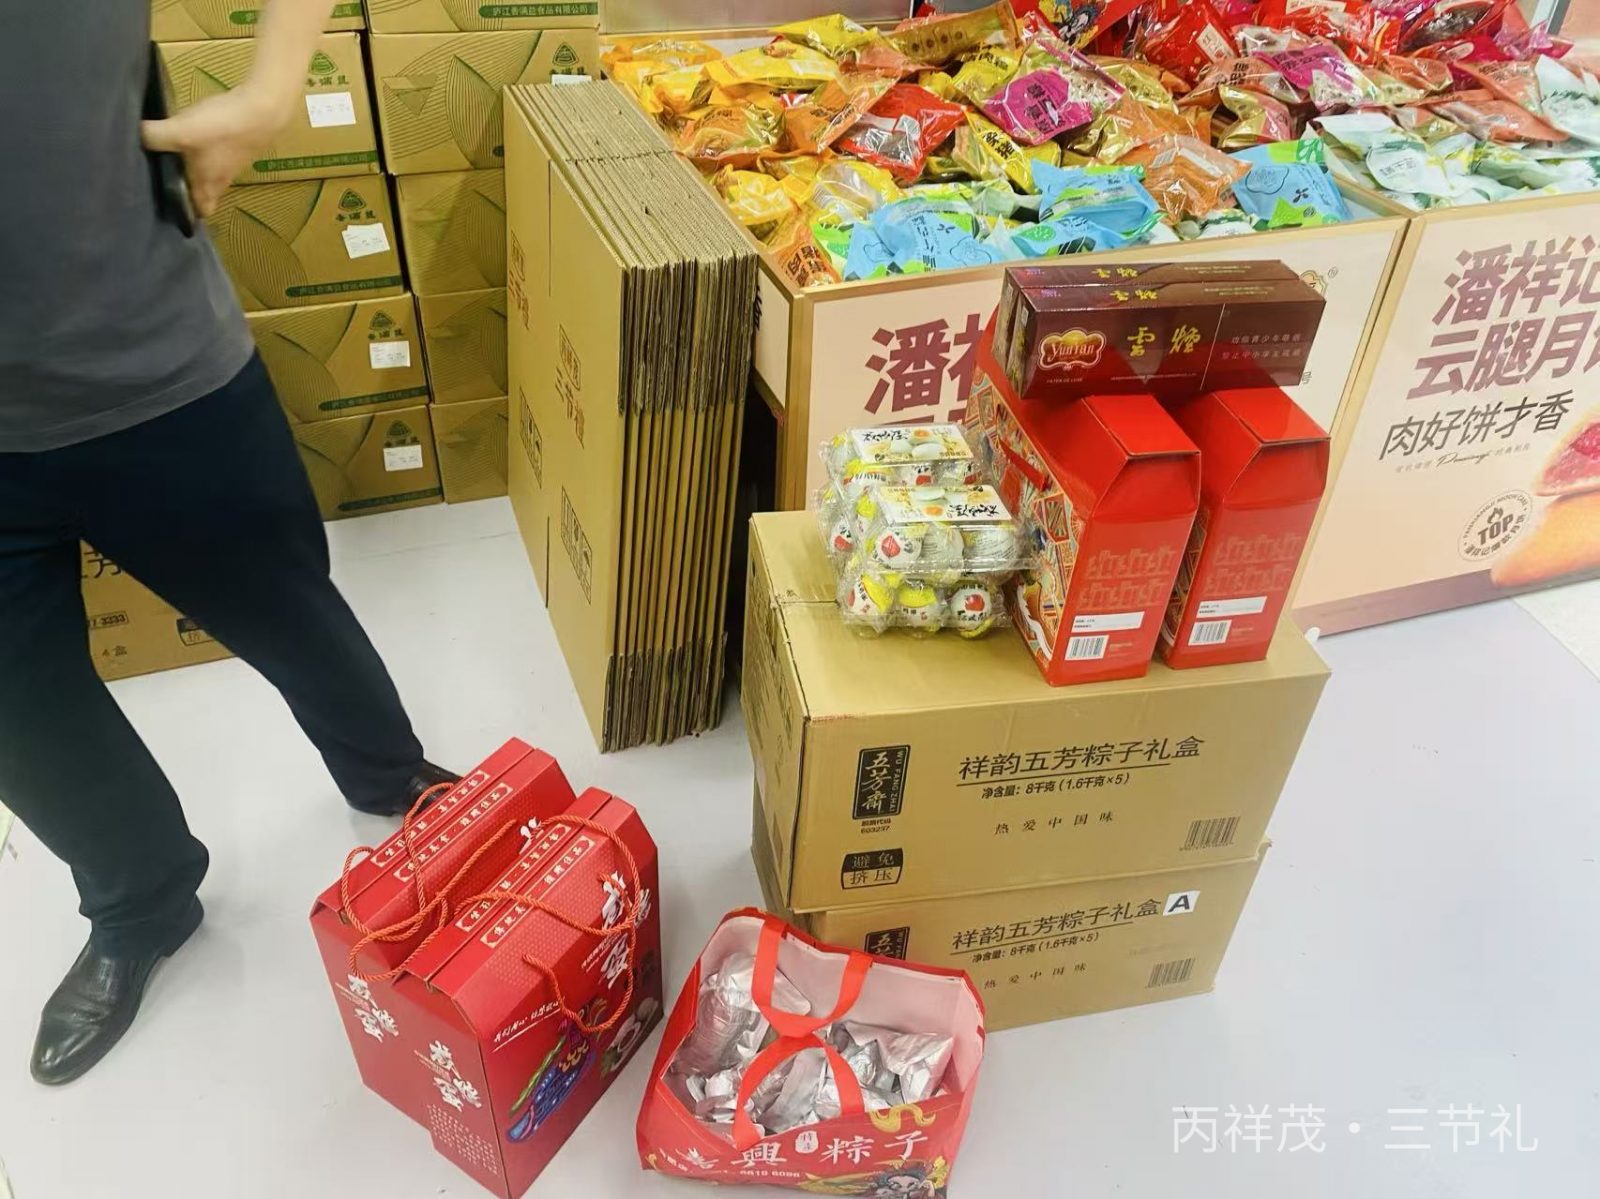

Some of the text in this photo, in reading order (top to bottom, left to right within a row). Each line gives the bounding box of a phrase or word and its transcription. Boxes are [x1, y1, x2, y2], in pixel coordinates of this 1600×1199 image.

[1431, 234, 1600, 328] 潘祥记
[1378, 388, 1574, 461] 肉好饼才香
[1478, 513, 1514, 546] TOP
[958, 735, 1206, 780] 祥韵五芳粽子礼盒
[994, 810, 1114, 836] 热爱中国味
[849, 867, 893, 885] 挤压
[1168, 894, 1191, 913] A
[952, 898, 1162, 950] 祥韵五芳粽子礼盒
[820, 1131, 929, 1166] 粽子
